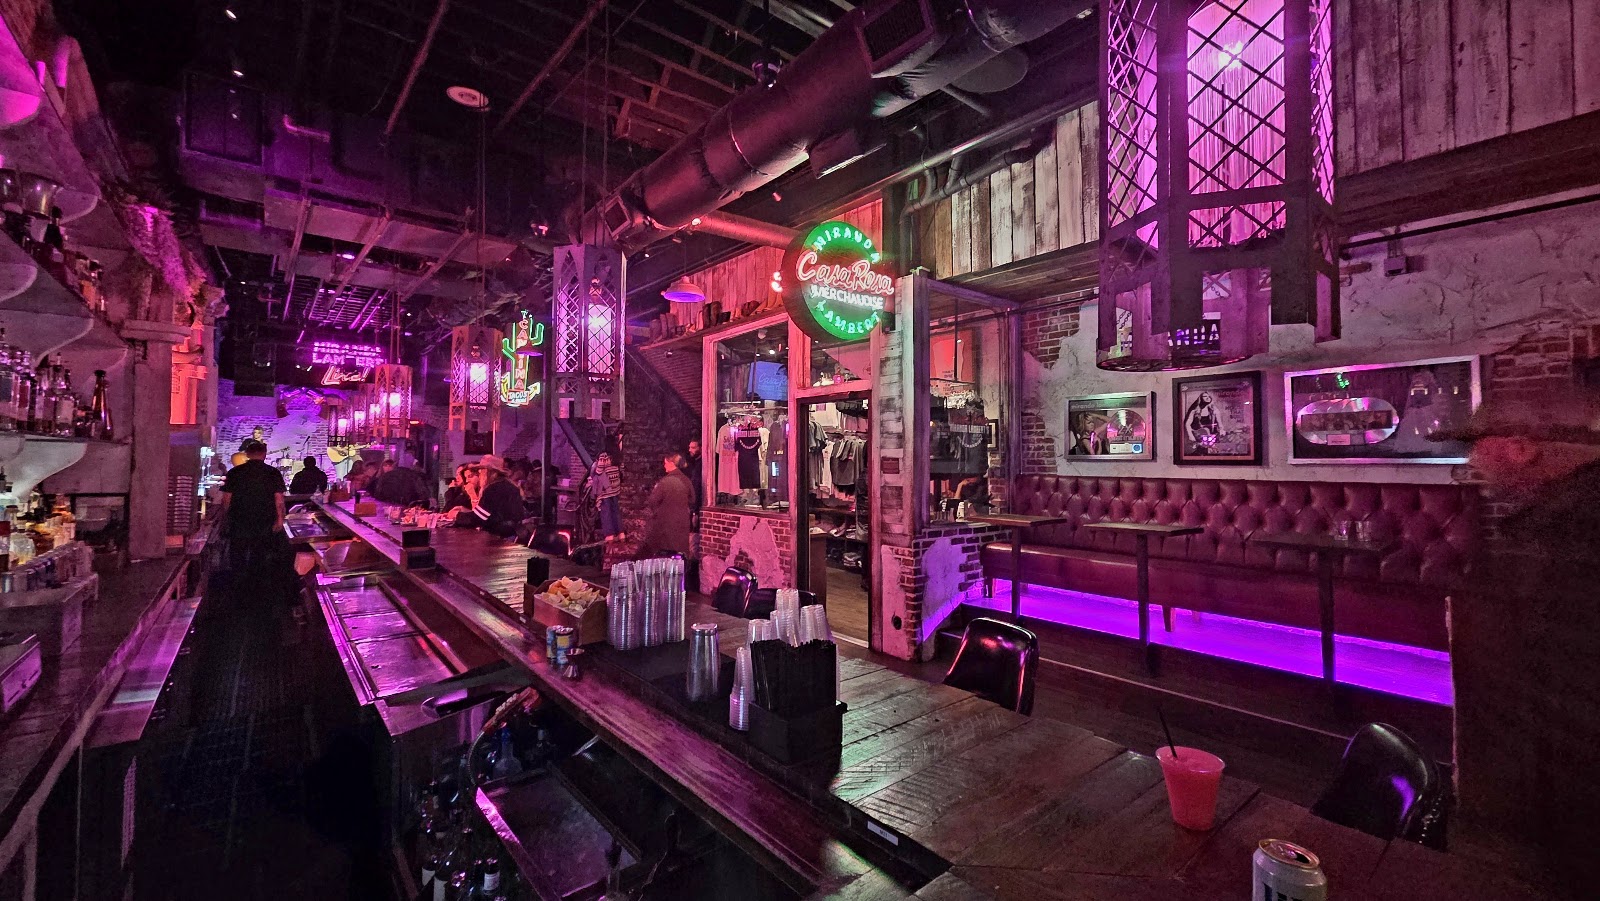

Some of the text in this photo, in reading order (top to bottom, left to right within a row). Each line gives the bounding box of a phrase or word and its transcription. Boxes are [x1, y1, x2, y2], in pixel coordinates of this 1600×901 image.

[812, 226, 881, 264] MIRANDA
[796, 250, 895, 295] Casa Rosa
[810, 284, 884, 309] MERCHANDISE
[816, 300, 880, 334] LAMBERT
[514, 316, 529, 389] CANINA
